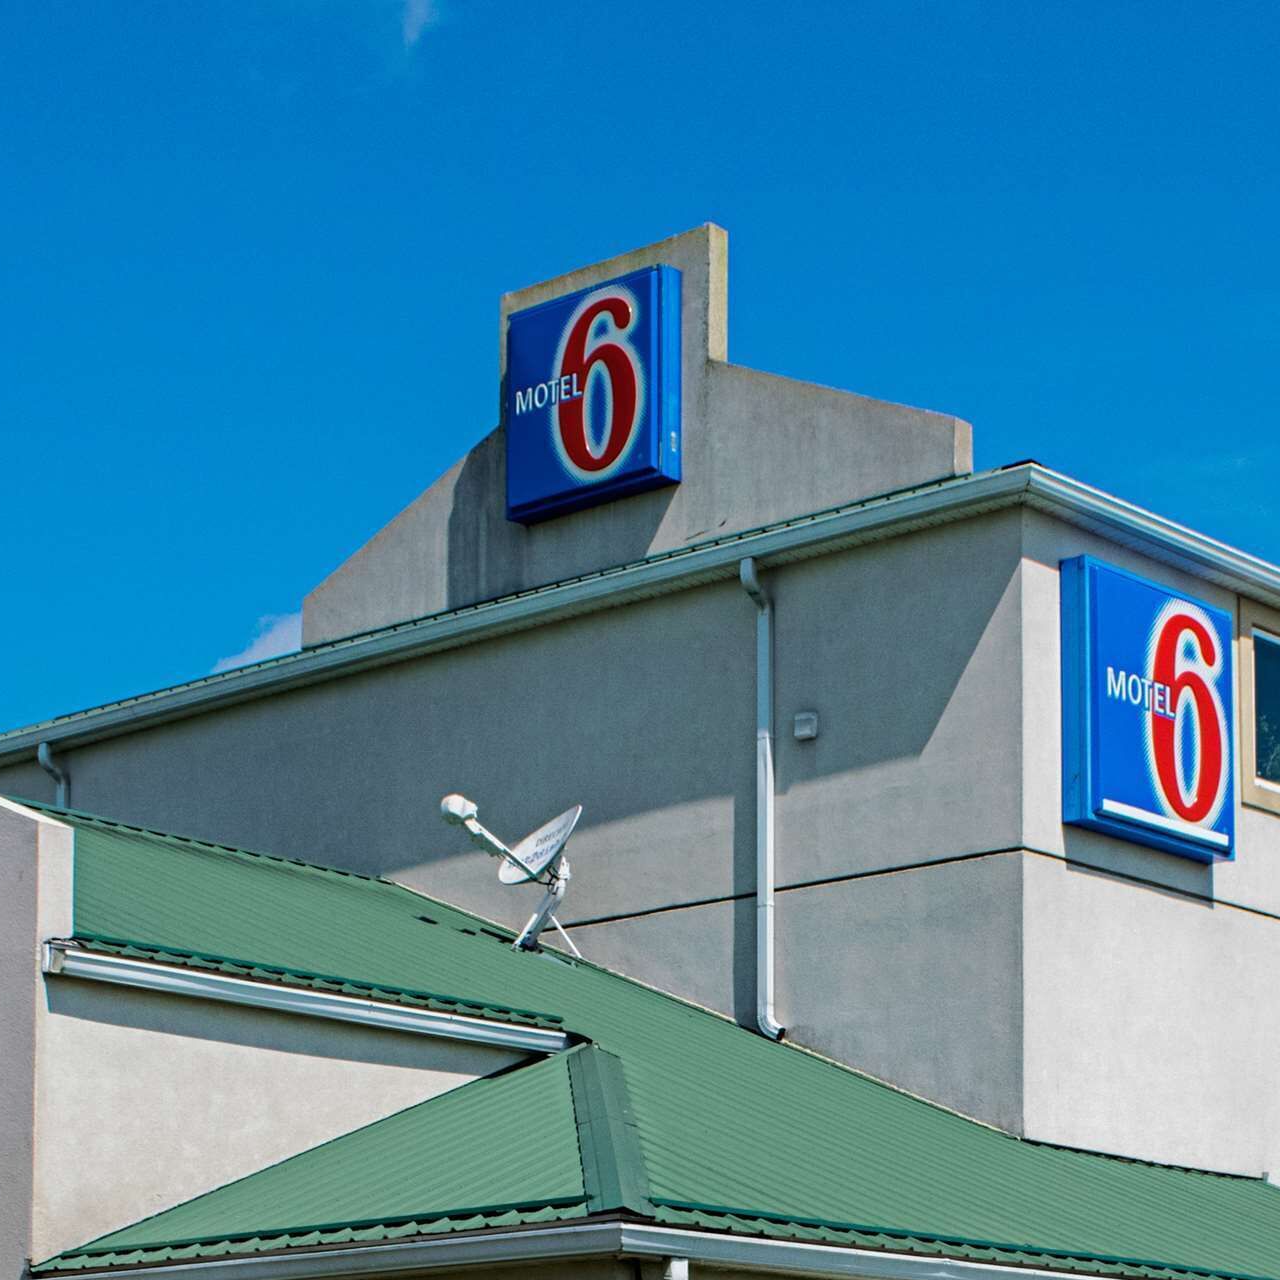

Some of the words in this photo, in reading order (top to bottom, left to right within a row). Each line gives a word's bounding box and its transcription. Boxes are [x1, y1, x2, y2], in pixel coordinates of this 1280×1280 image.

[515, 373, 583, 415] MOTEL
[553, 286, 643, 479] 6
[1106, 666, 1176, 718] MOTEL
[1147, 600, 1227, 828] 6
